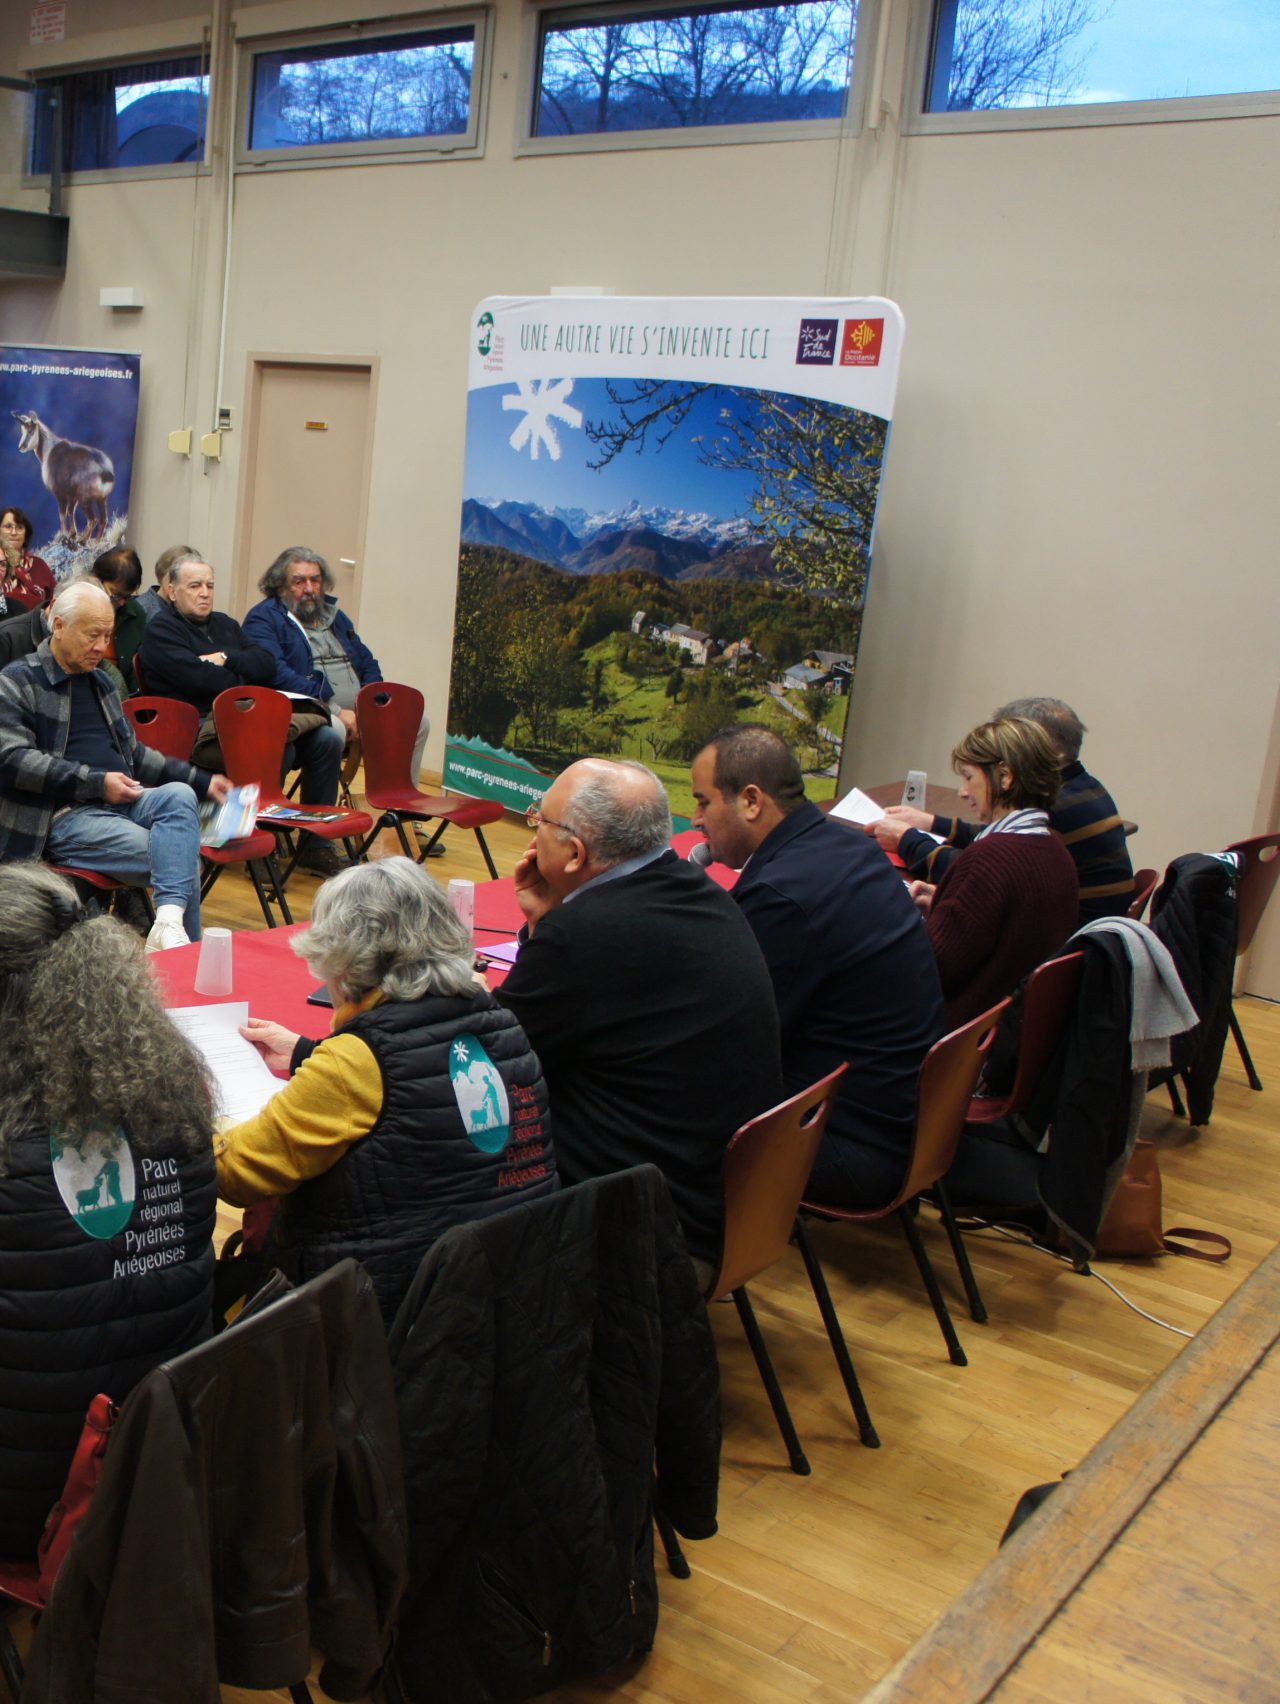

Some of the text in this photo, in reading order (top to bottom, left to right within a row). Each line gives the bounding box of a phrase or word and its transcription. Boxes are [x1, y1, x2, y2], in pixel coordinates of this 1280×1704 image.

[520, 323, 770, 359] UNE AUTRE VIE S'INVENTE ICI
[813, 329, 831, 342] Sud
[802, 343, 831, 358] France
[844, 353, 875, 361] Occitanie
[141, 1158, 178, 1181] Parc
[143, 1179, 180, 1200] naturel
[140, 1197, 183, 1222] régional
[125, 1222, 185, 1252] Pyrénées
[113, 1245, 186, 1279] Ariégeoises
